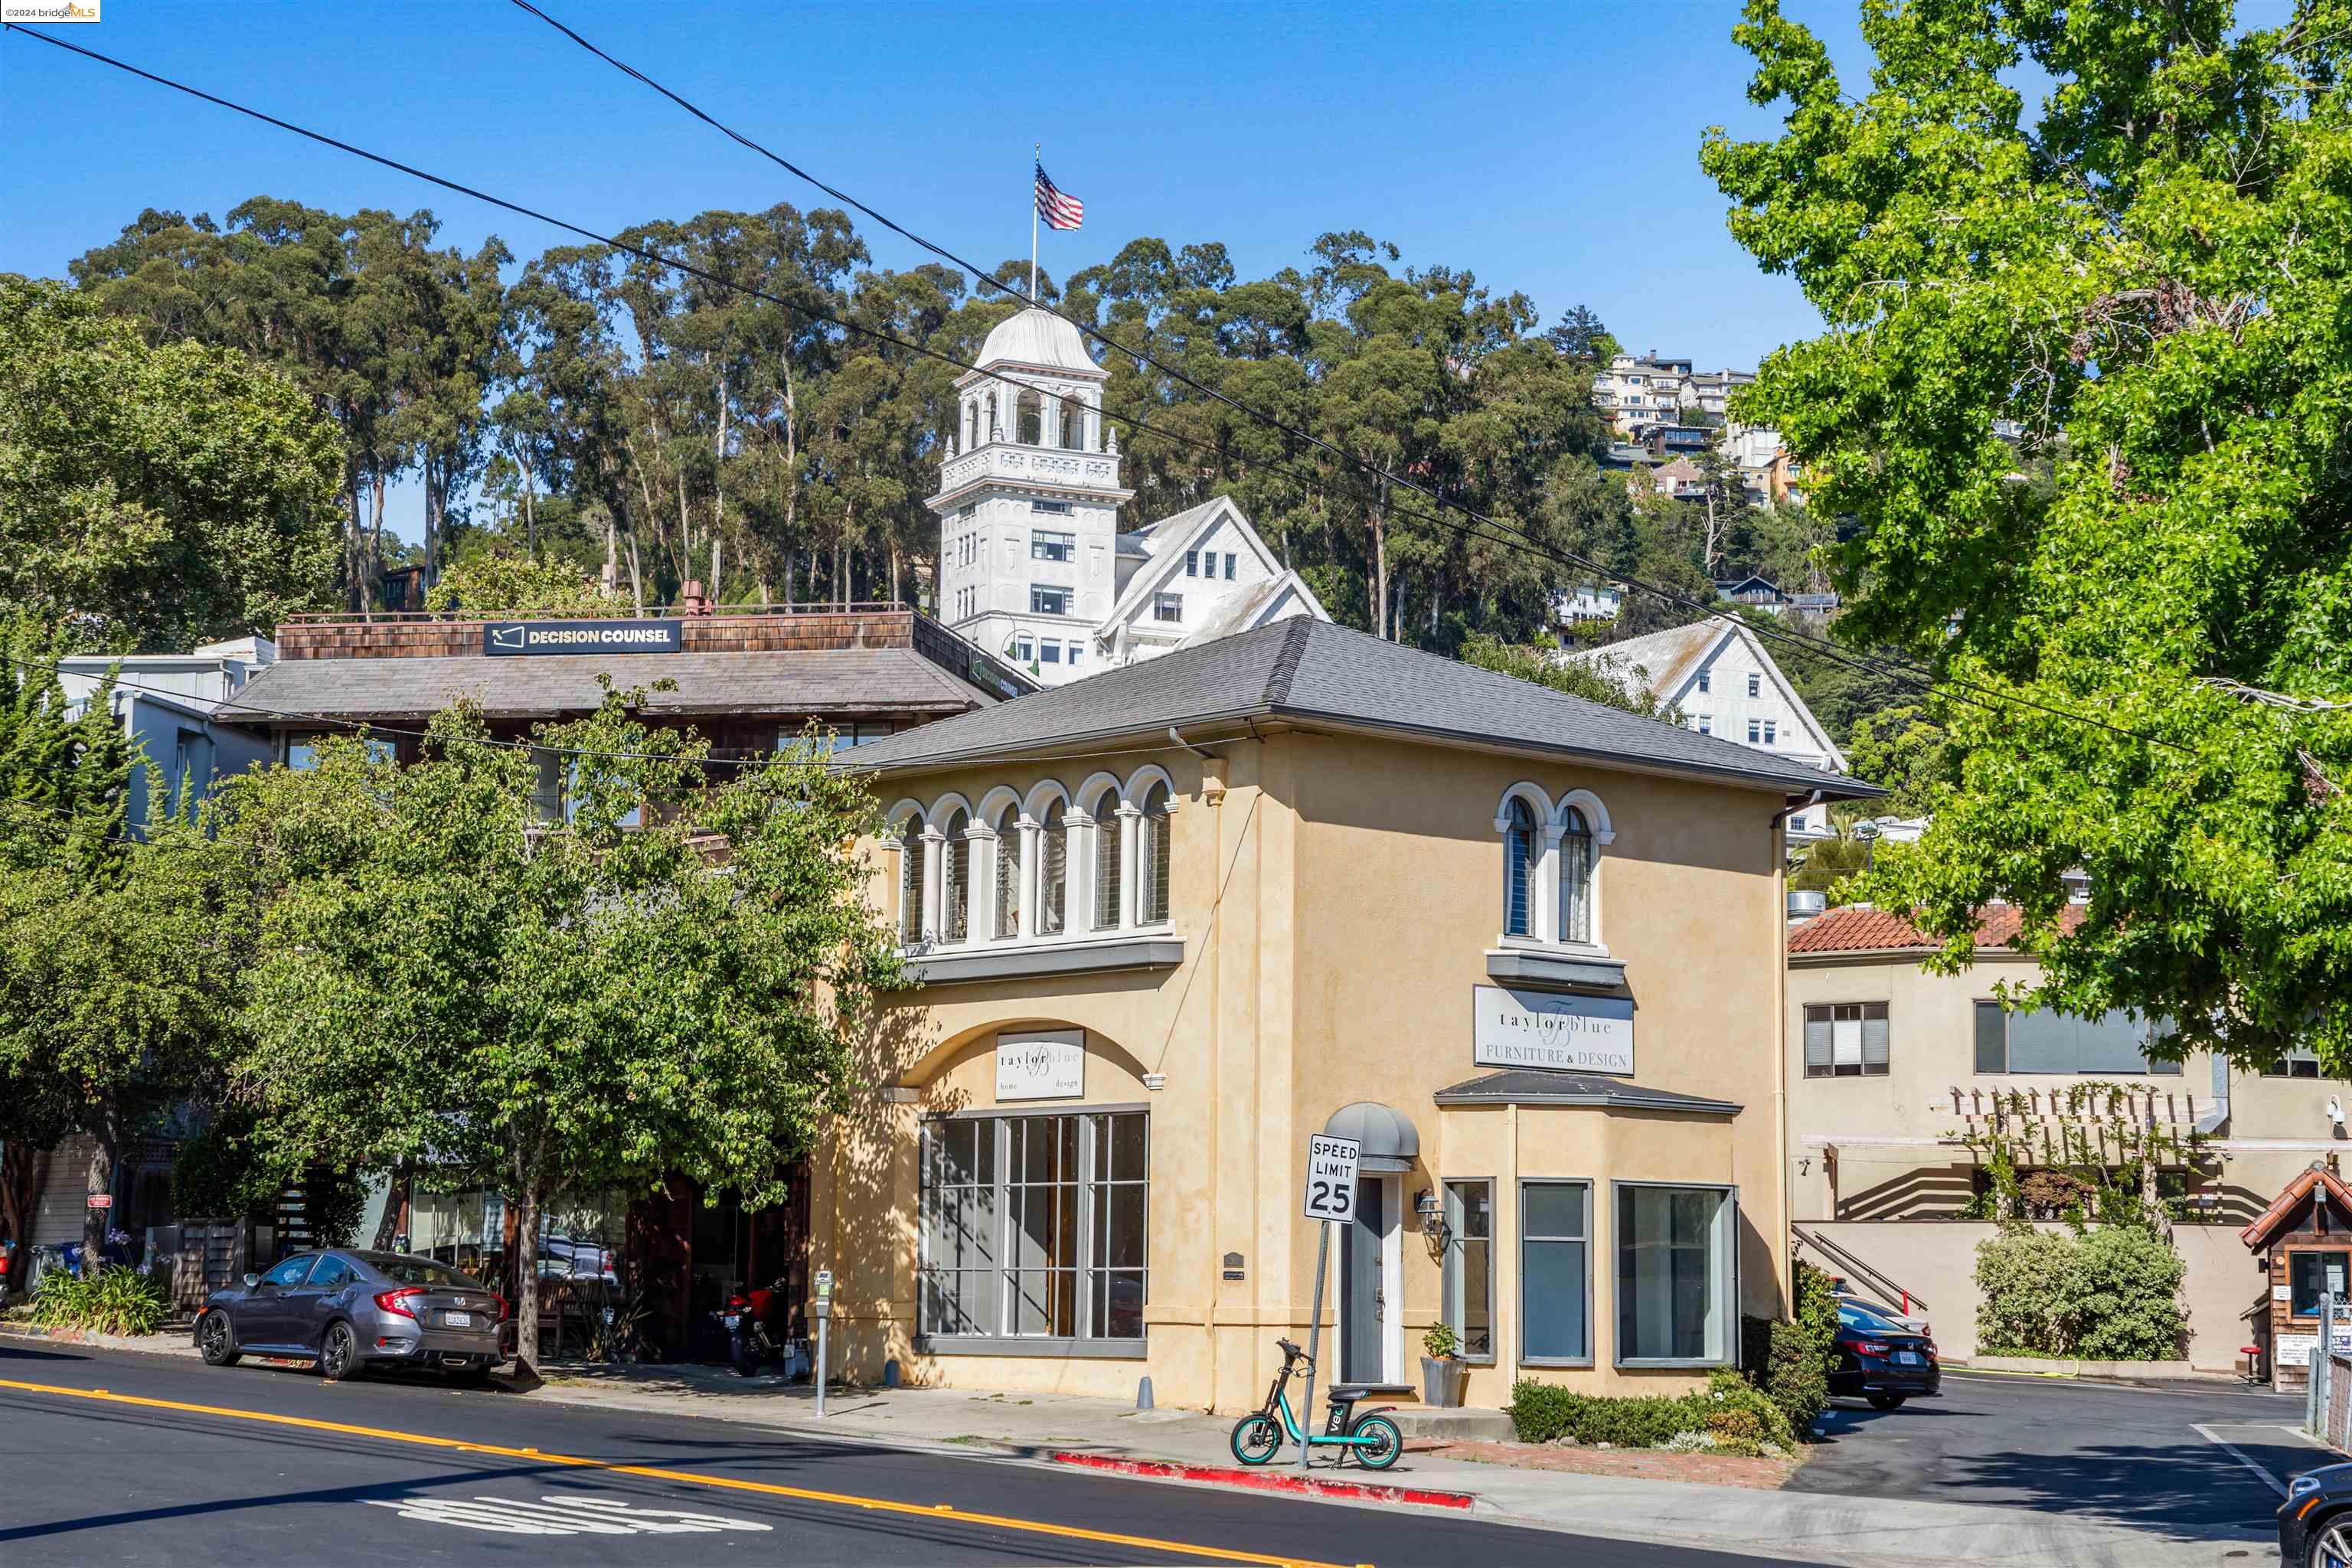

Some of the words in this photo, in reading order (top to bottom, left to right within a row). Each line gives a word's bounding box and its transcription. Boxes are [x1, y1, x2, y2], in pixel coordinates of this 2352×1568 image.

[529, 631, 599, 644] DECISION
[601, 629, 671, 643] COUNSEL
[1486, 1044, 1564, 1063] FURNITURE
[1566, 1054, 1574, 1064] &
[1577, 1051, 1628, 1067] DESIGN
[1000, 1081, 1018, 1090] home
[1055, 1078, 1078, 1089] design
[1313, 1142, 1357, 1159] SPEED
[1316, 1161, 1351, 1178] LIMIT
[1310, 1181, 1350, 1214] 25
[1330, 1408, 1343, 1432] veo
